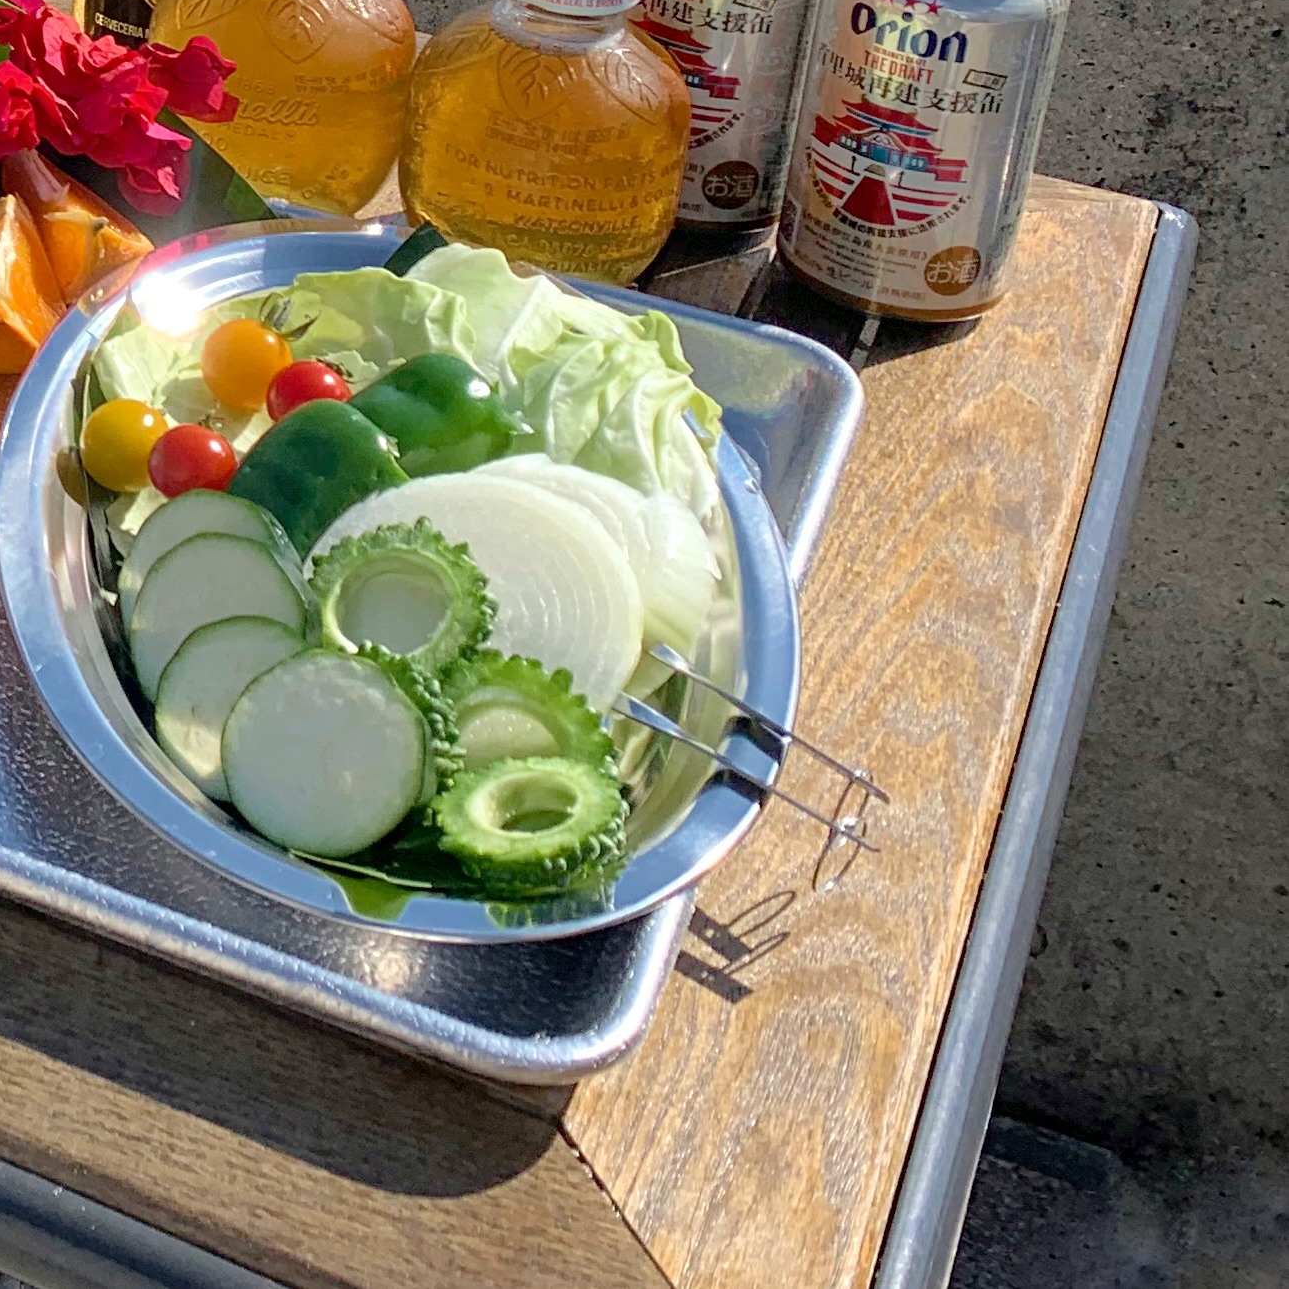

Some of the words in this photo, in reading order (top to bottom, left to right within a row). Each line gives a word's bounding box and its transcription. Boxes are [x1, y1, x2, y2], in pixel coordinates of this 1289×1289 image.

[95, 12, 144, 38] CERVECERIA
[851, 2, 968, 63] Orion
[864, 50, 888, 73] THE
[889, 60, 934, 84] DRAFT
[703, 173, 756, 198] お酒
[926, 259, 979, 285] お酒
